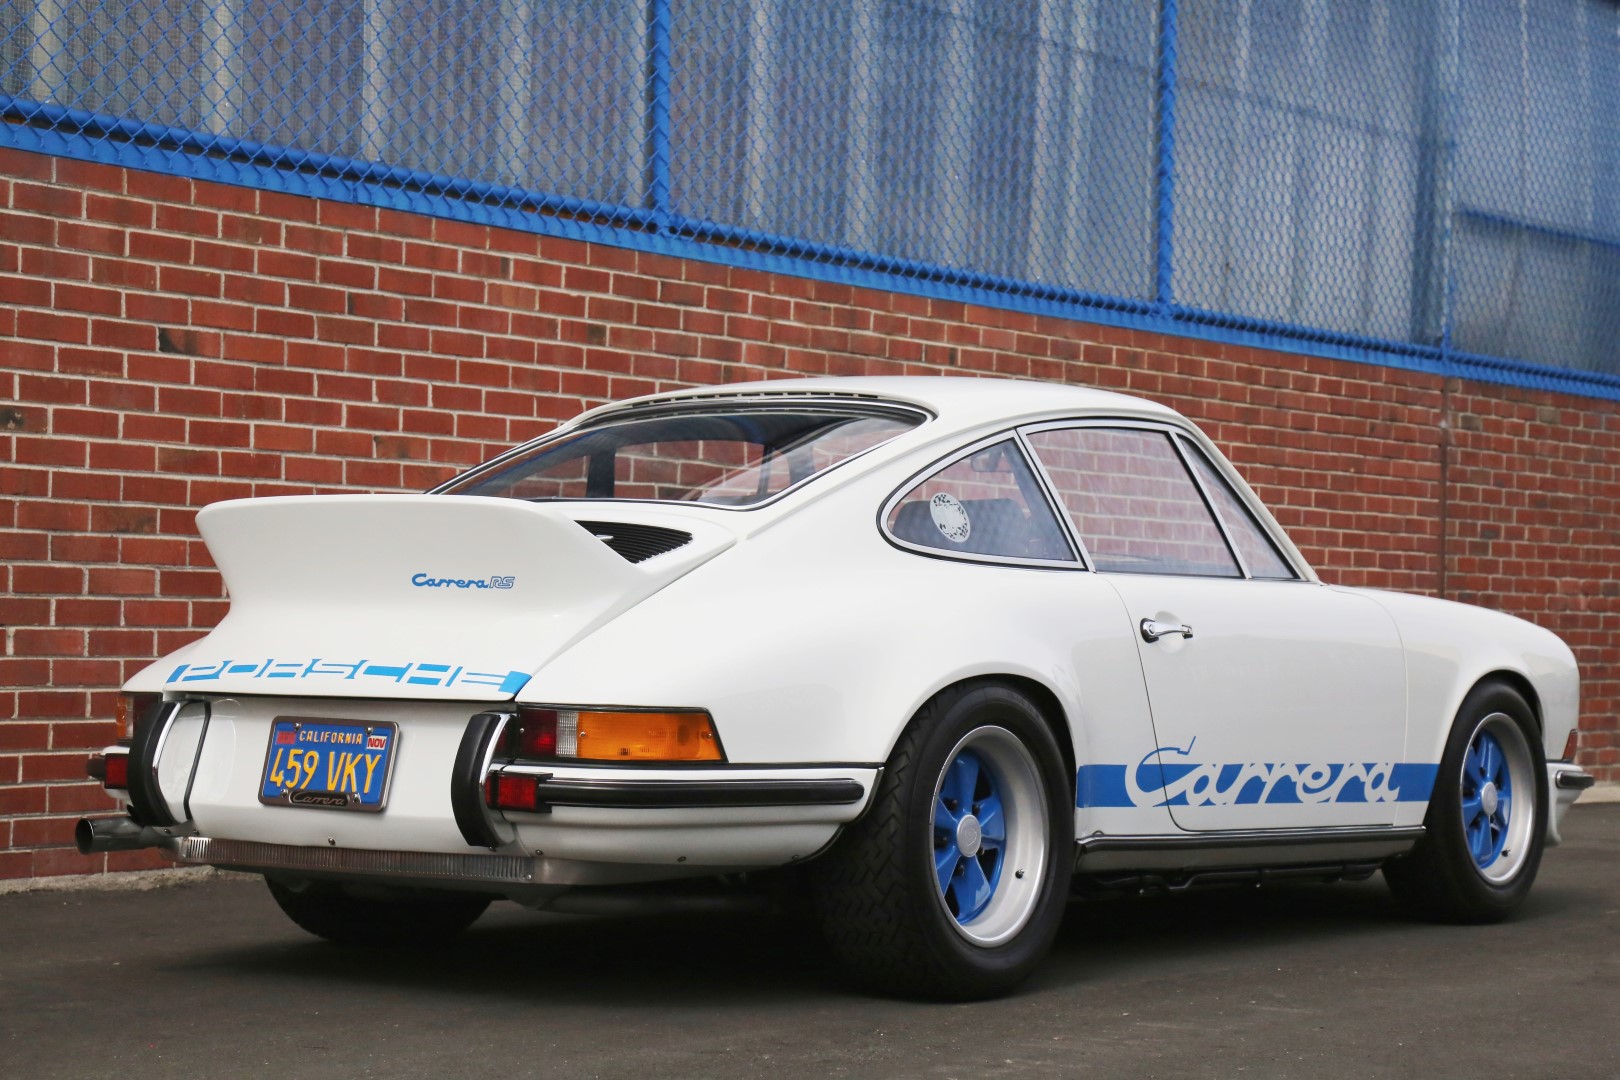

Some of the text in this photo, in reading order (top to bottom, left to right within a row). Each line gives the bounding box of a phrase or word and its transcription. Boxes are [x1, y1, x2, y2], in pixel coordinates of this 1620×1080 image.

[411, 573, 516, 589] Carrera RS
[166, 658, 532, 694] PORSCHE
[299, 730, 363, 745] CALIFORNIA
[367, 737, 387, 749] NOV
[269, 748, 382, 794] 459 VKY
[1125, 736, 1400, 808] Carrera
[292, 791, 346, 806] Carrera
